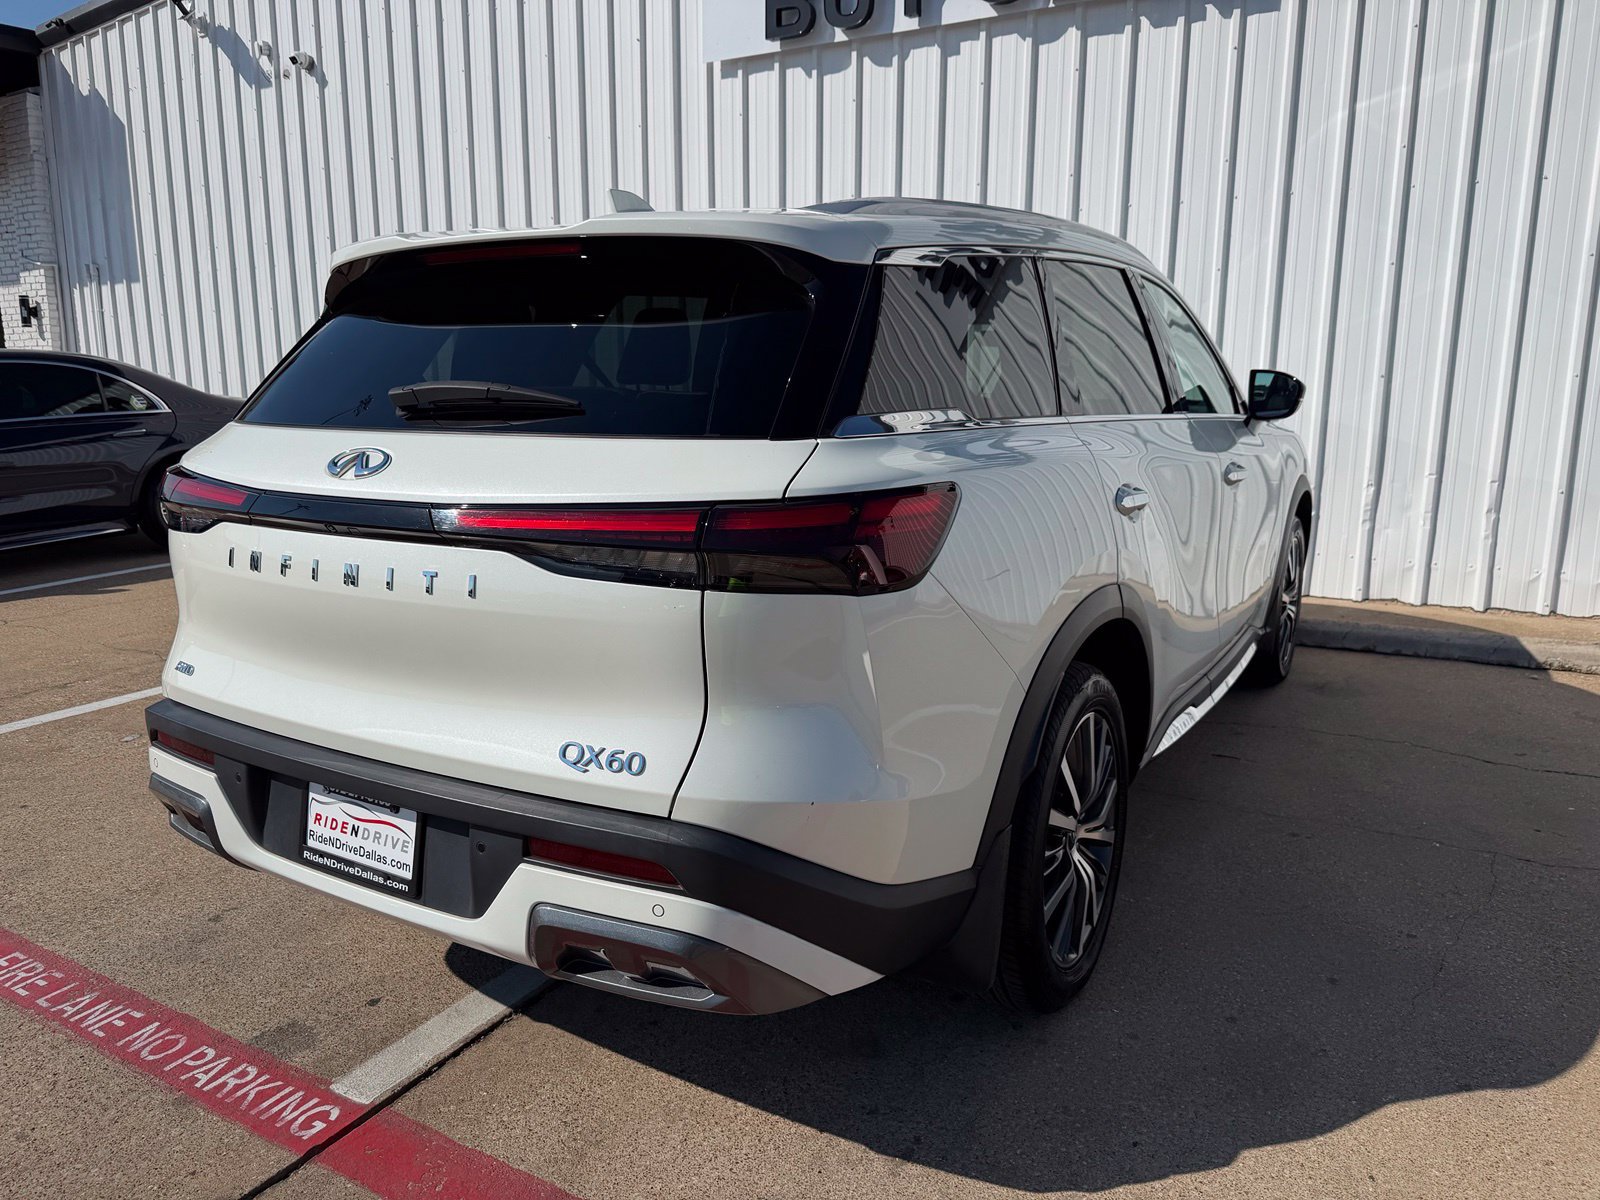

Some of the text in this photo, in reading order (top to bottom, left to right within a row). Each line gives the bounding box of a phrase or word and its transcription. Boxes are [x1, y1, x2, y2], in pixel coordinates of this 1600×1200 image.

[228, 546, 477, 599] INFINITI
[558, 741, 647, 776] QX60
[308, 829, 411, 873] RideNDriveDallas.com
[313, 812, 411, 854] RIDENDRIVE
[303, 850, 409, 892] RideNDriveDallas.com
[0, 951, 341, 1141] FIRE LANE NO PARKING
